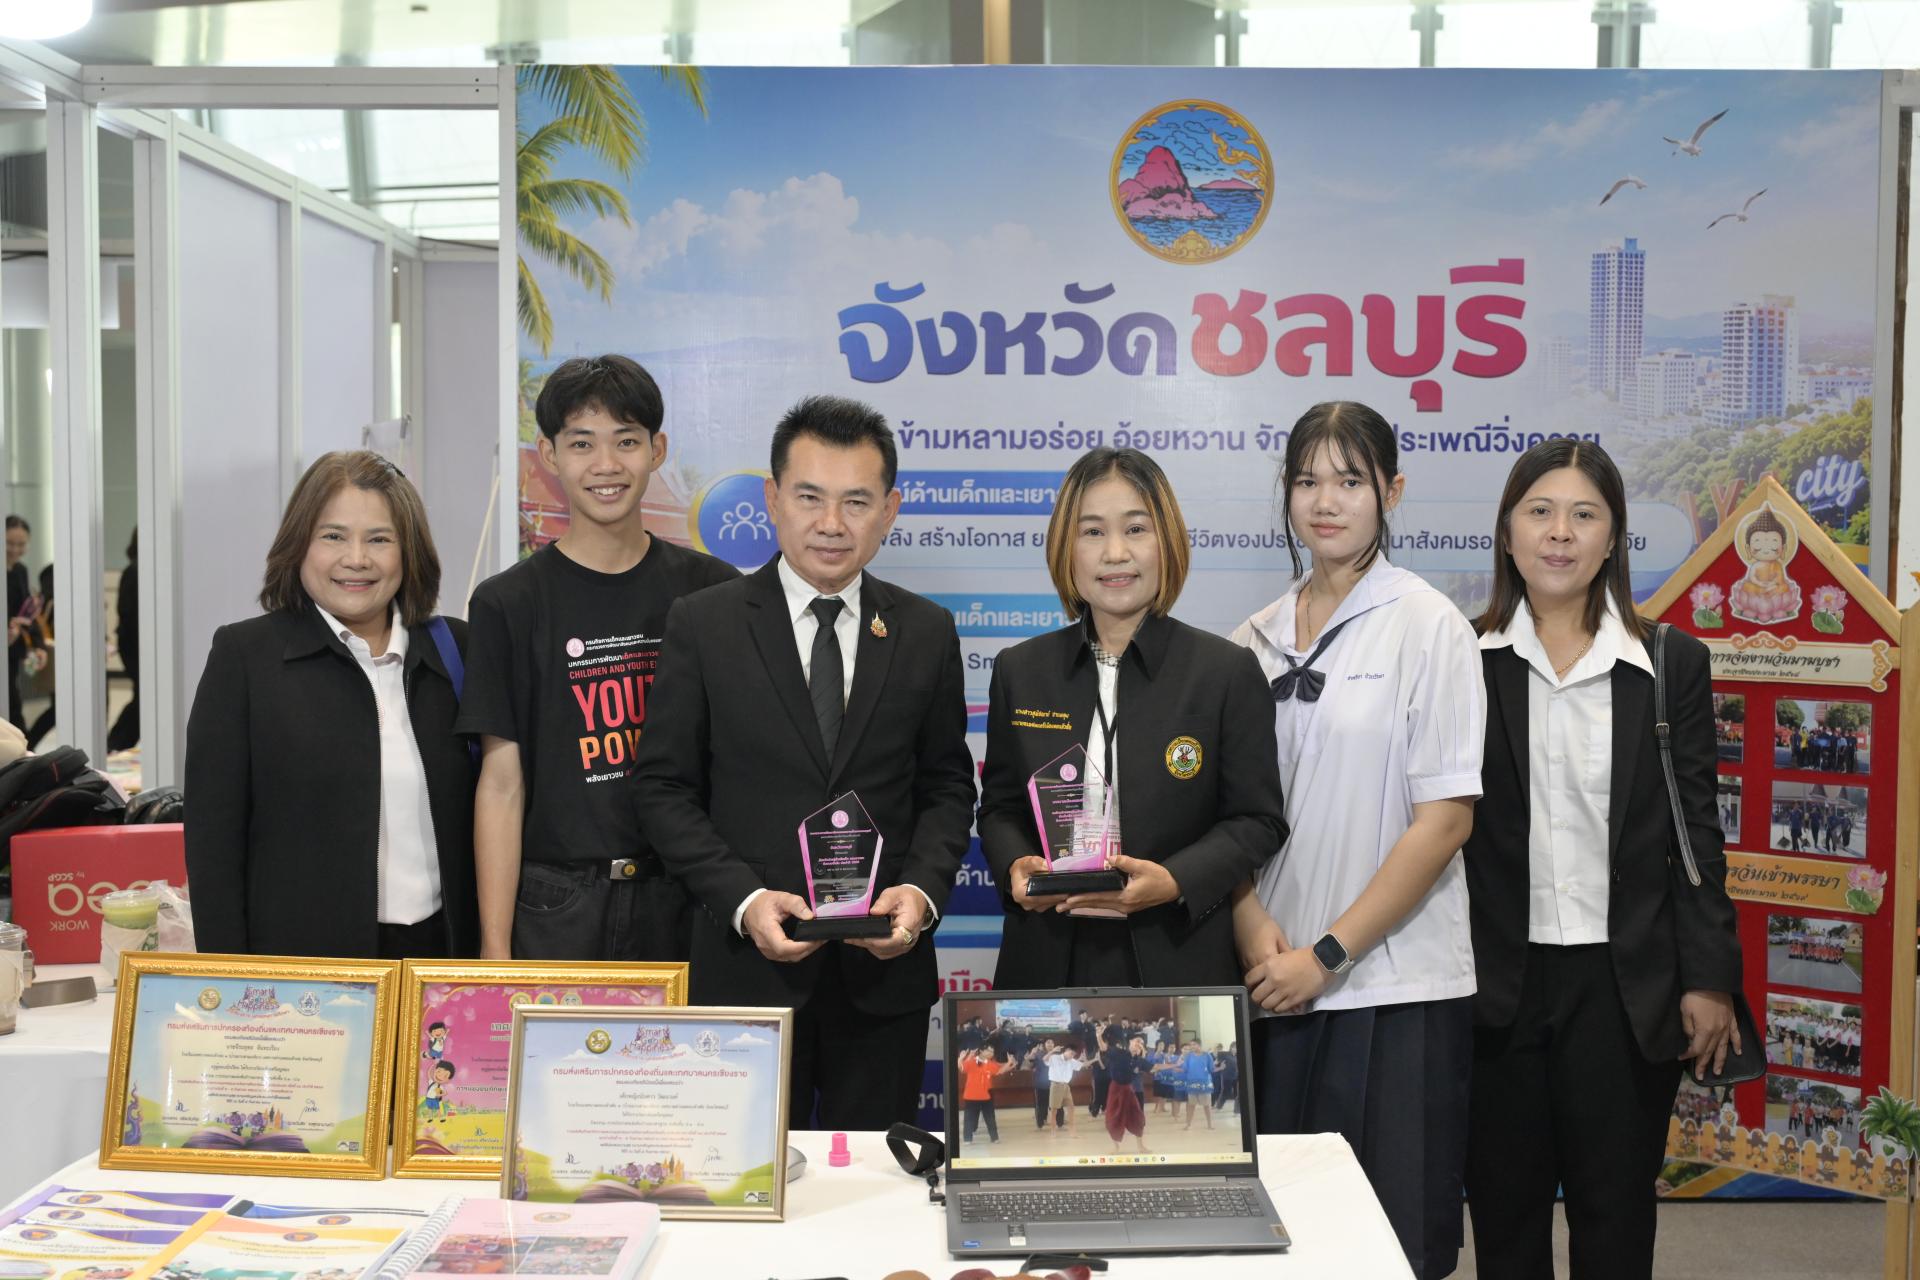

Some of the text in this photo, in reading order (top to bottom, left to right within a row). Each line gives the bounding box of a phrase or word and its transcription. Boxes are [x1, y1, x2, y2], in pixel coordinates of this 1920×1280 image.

[838, 257, 1528, 413] จังหวัดชลบุรี
[1113, 421, 1245, 451] อ้อยหวาน
[1796, 455, 1866, 508] city
[919, 526, 1026, 547] สร้างโอกาส
[569, 666, 608, 680] CHILDREN
[610, 662, 626, 674] AND
[48, 872, 74, 881] SCGP
[50, 919, 90, 932] WORK
